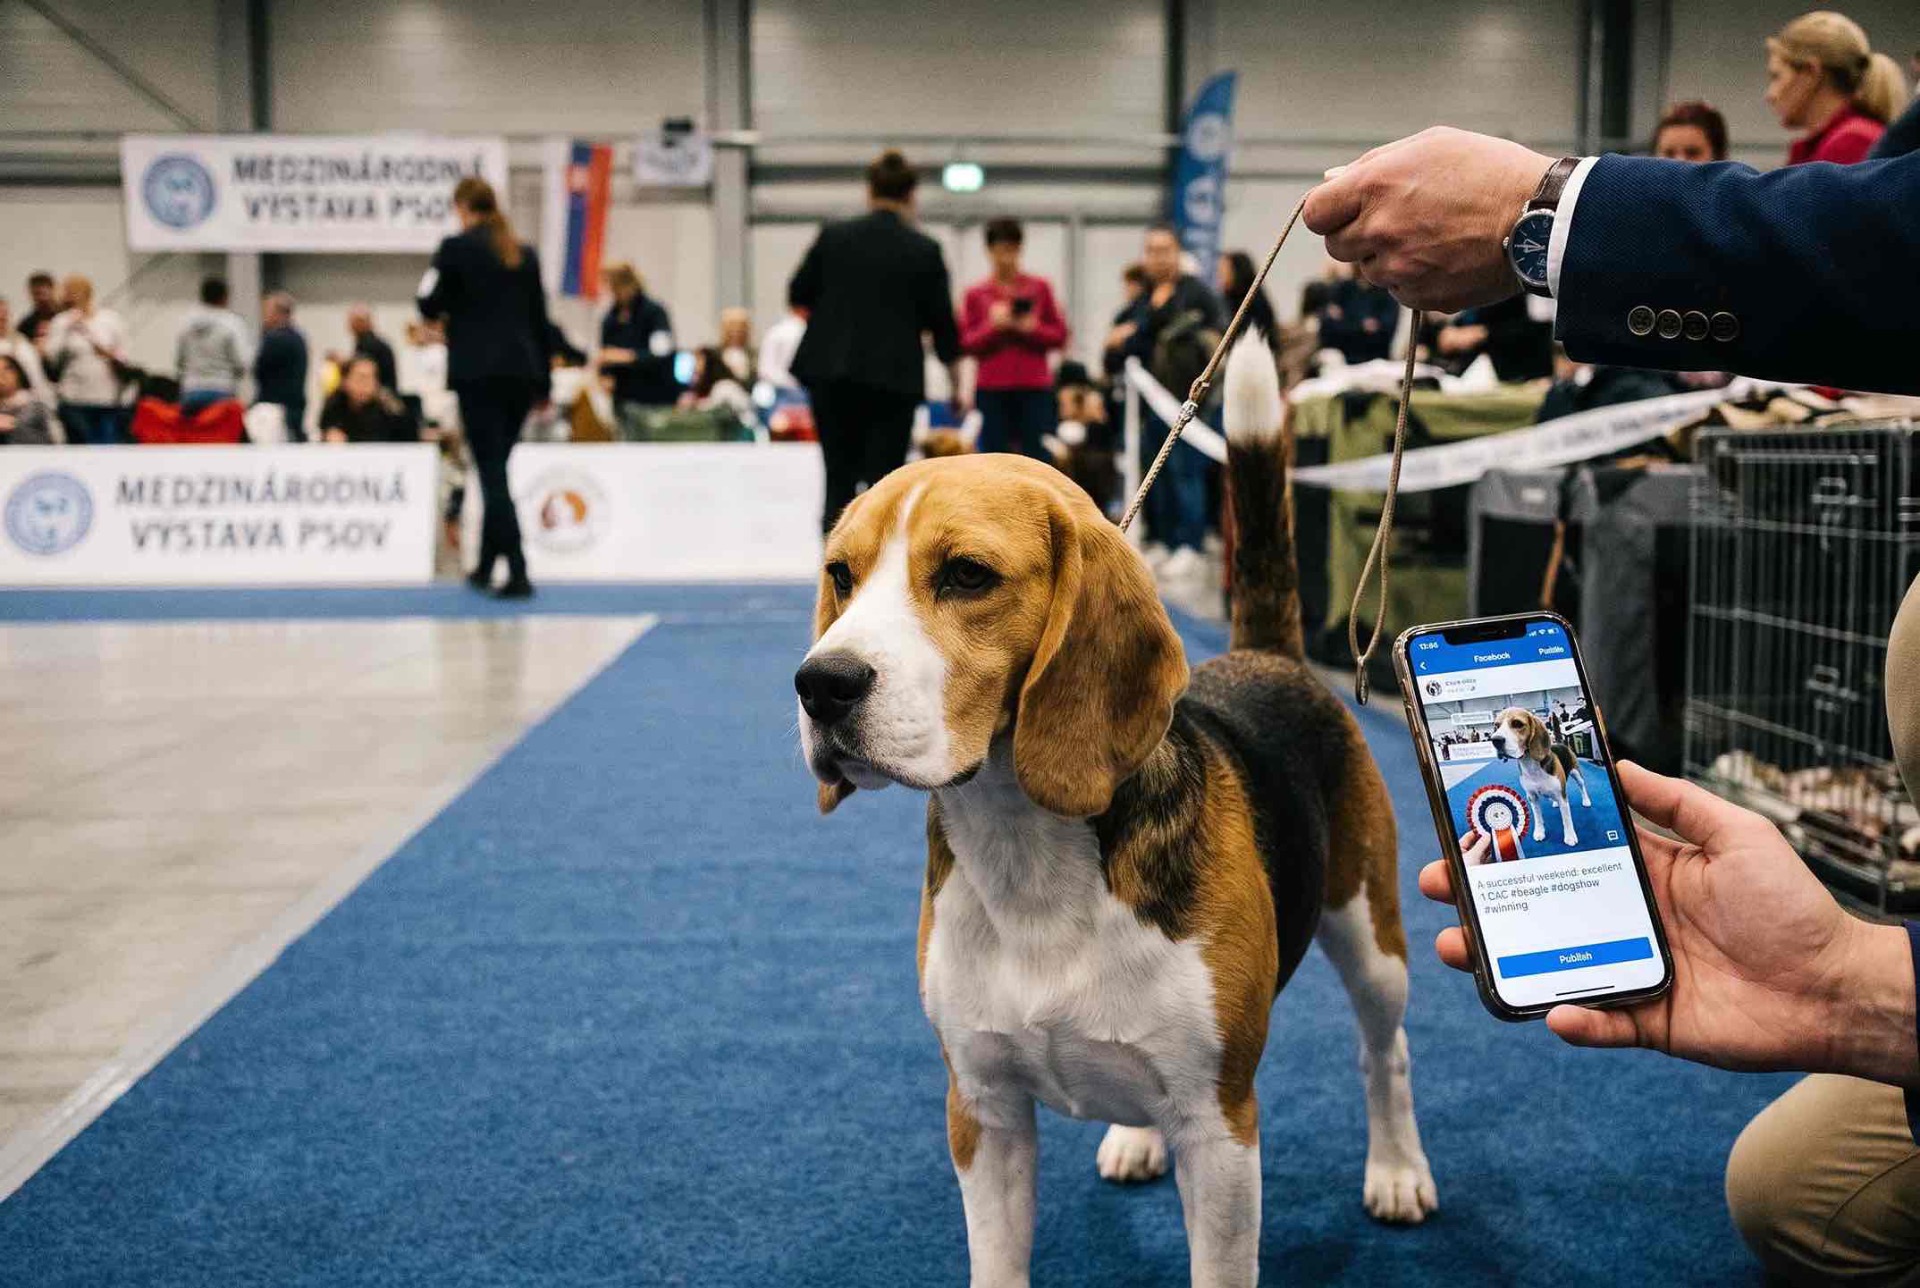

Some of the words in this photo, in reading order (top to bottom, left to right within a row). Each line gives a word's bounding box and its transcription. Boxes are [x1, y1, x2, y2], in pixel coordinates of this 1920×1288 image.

[299, 518, 391, 549] PSOV
[1474, 652, 1510, 663] Facebook
[1478, 880, 1484, 889] A
[1486, 874, 1534, 888] successful
[1582, 863, 1622, 875] excellent
[1488, 890, 1508, 901] CAC
[1511, 885, 1549, 897] #beagle
[1551, 879, 1600, 892] #dogshow
[1484, 902, 1528, 914] #winning
[1559, 951, 1593, 964] Publish
